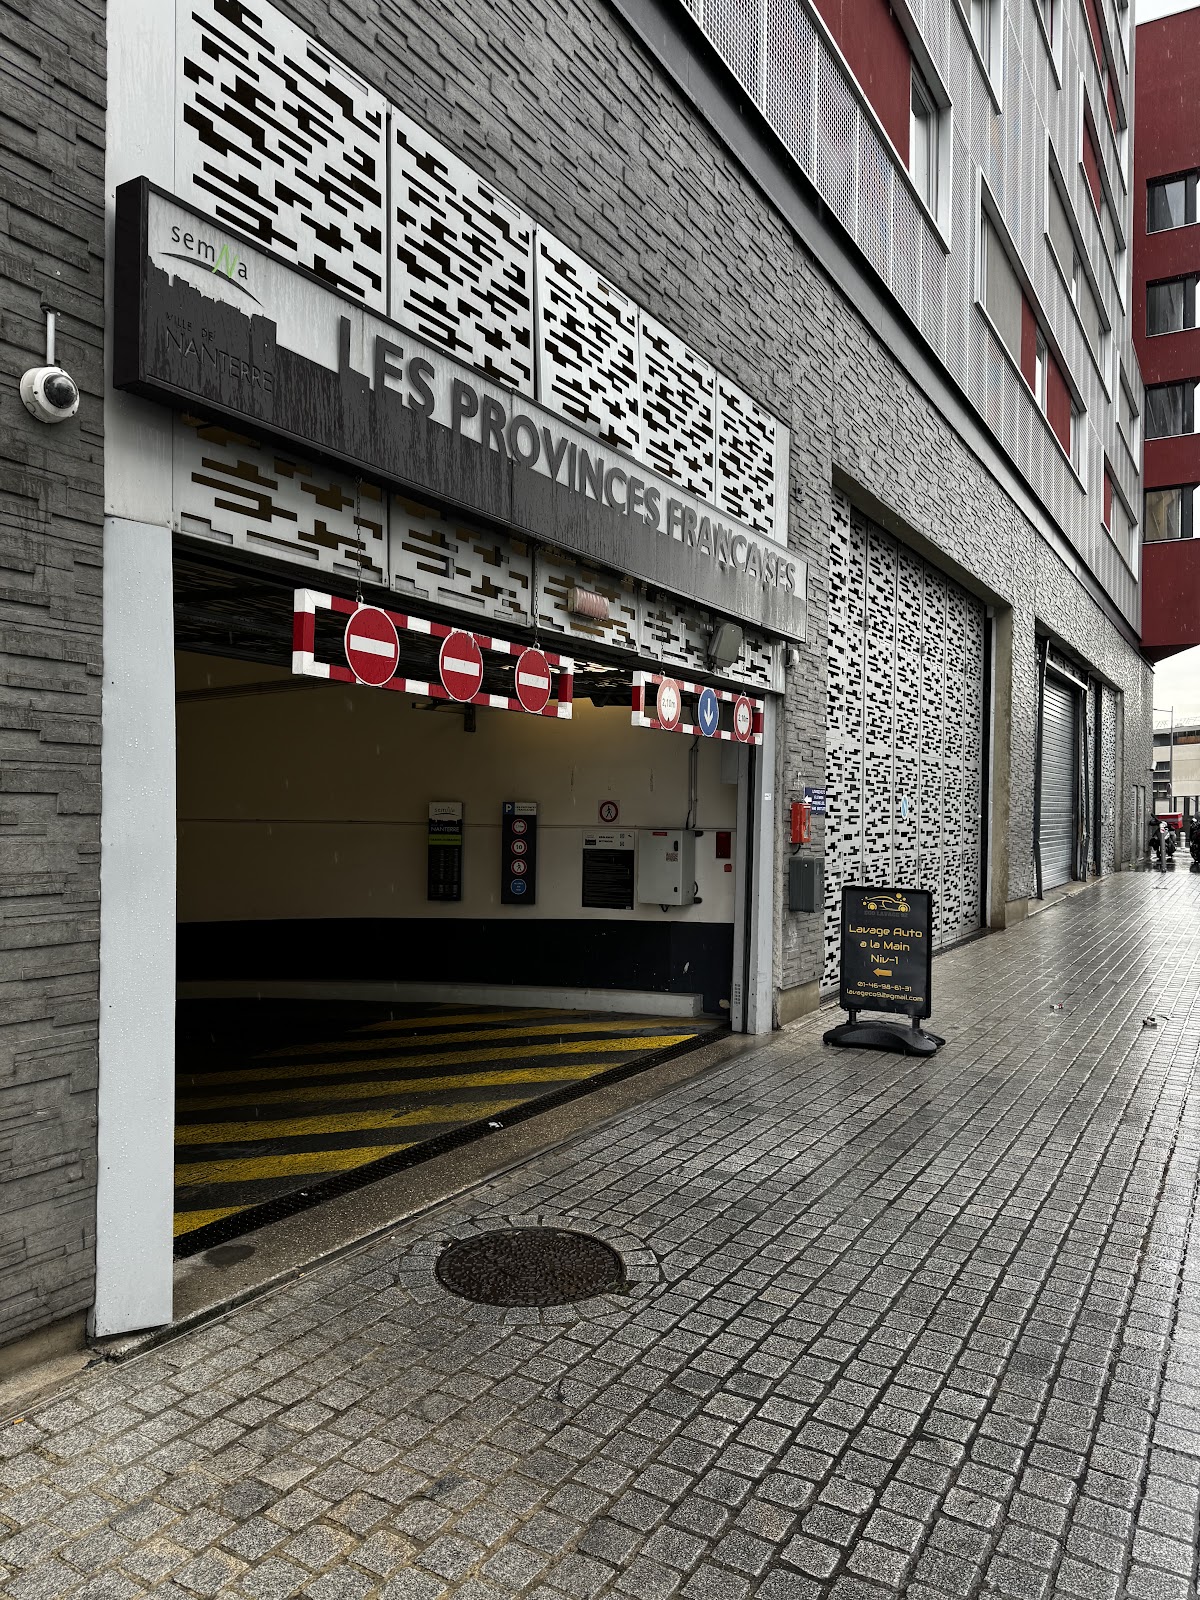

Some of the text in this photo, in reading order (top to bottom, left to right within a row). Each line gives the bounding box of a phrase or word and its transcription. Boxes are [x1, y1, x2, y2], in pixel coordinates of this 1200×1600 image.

[166, 311, 216, 342] VILLE DE
[165, 325, 273, 394] NANTERRE
[340, 315, 436, 418] LES
[451, 377, 661, 531] PROVINCES
[505, 803, 513, 813] P
[849, 924, 923, 938] Lavage Auto
[870, 939, 880, 949] la
[883, 941, 910, 952] Main
[870, 954, 899, 965] Niv-1
